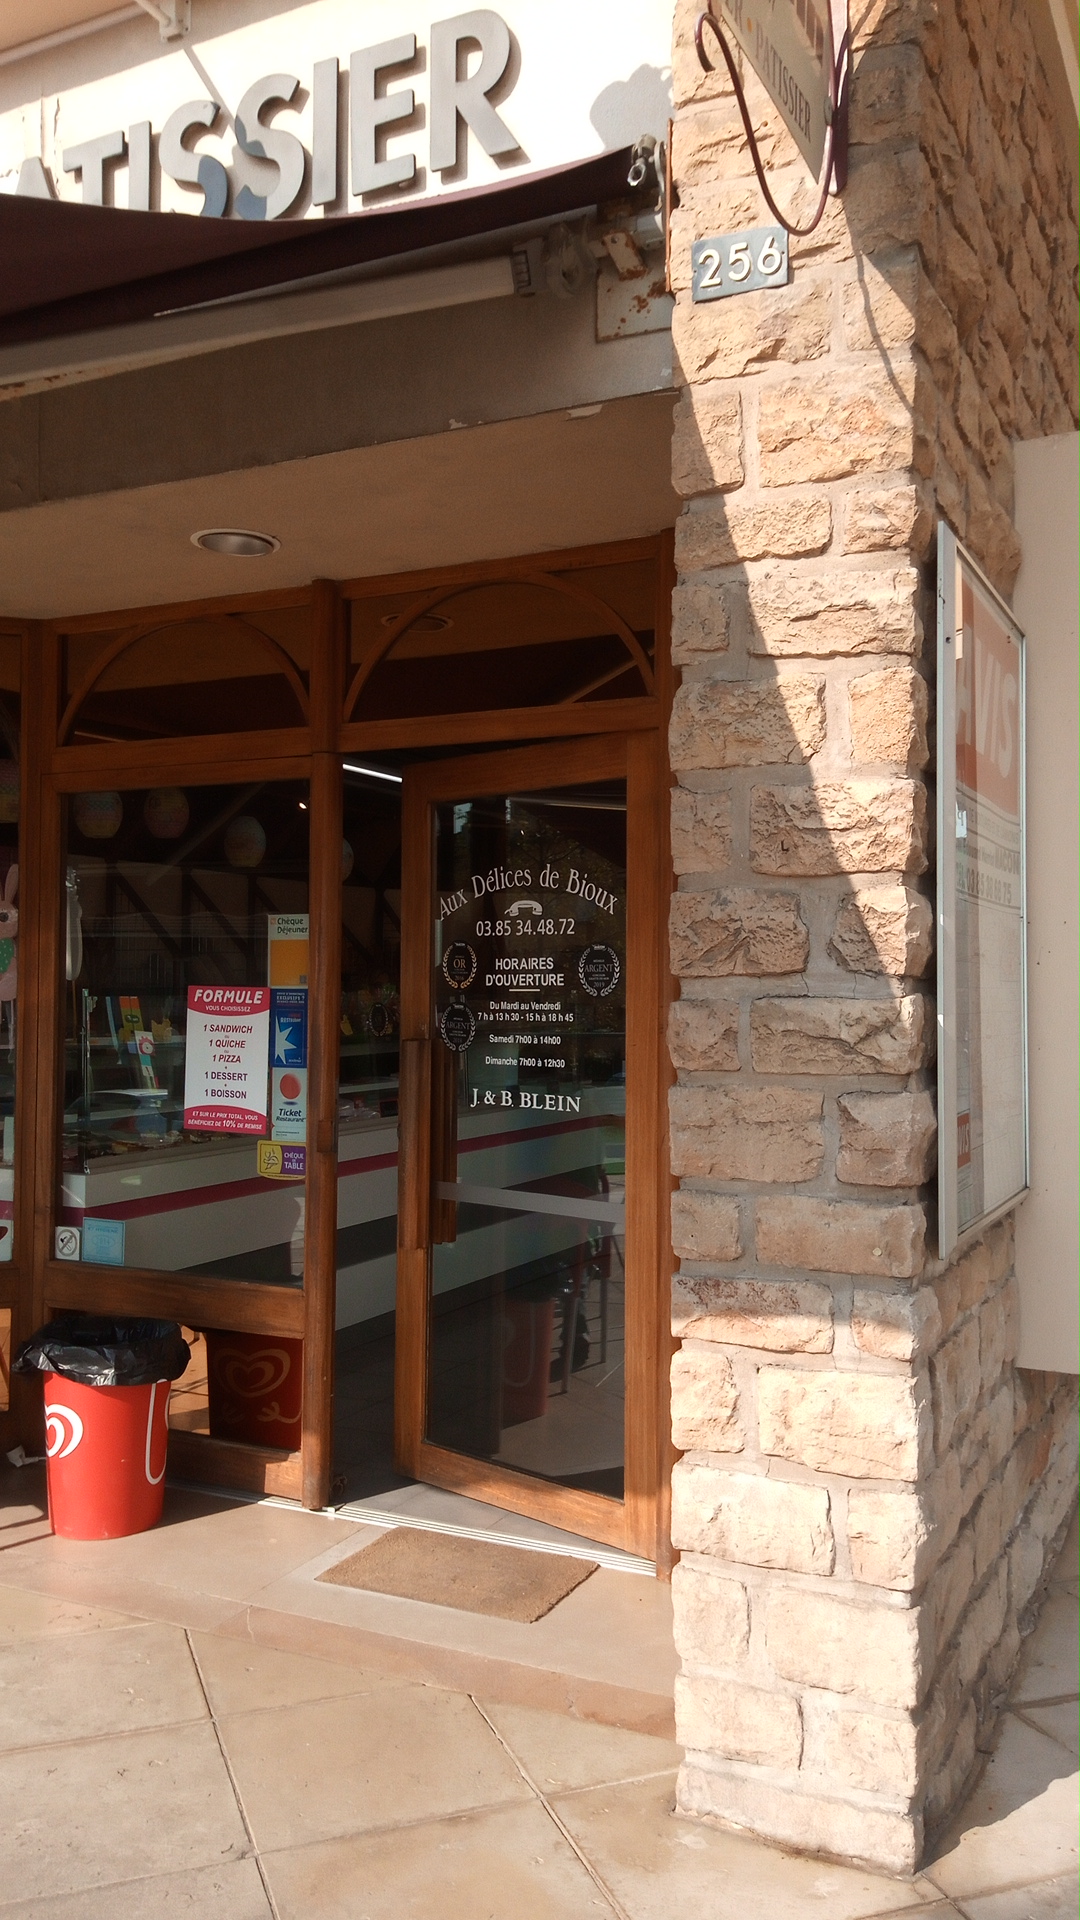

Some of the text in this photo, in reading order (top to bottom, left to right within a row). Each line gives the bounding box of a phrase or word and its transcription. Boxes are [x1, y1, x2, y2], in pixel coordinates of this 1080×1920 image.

[755, 17, 811, 144] PATISSIER
[698, 236, 782, 288] 256
[440, 864, 618, 921] Aux Délices de Bioux
[277, 917, 304, 926] Chèque
[278, 926, 308, 936] Déjeuner
[476, 919, 575, 936] 03.85 34.48.72
[453, 958, 466, 968] OR
[495, 957, 554, 970] HORAIRES
[584, 963, 613, 972] ARGENT
[485, 974, 564, 986] D'OUVERTURE
[194, 989, 263, 1004] FORMULE
[489, 1001, 499, 1010] Du
[500, 1001, 520, 1010] Mardi
[530, 1001, 561, 1010] Vendredi
[477, 1012, 482, 1020] 7
[484, 1012, 488, 1020] h
[489, 1012, 494, 1020] à
[496, 1012, 504, 1020] 13
[504, 1012, 510, 1020] h
[526, 1013, 534, 1021] 15
[535, 1013, 540, 1021] h
[542, 1013, 546, 1022] à
[548, 1014, 557, 1022] 18
[558, 1014, 564, 1022] h
[564, 1014, 574, 1022] 45
[210, 1024, 253, 1034] SANDWICH
[446, 1021, 470, 1030] ARGENT
[216, 1040, 246, 1048] QUICHE
[489, 1034, 561, 1045] Samedi 7h00 à 14h00
[218, 1054, 241, 1063] PIZZA
[485, 1056, 566, 1068] Dimanche 7h00 à 12h30
[204, 1071, 248, 1081] 1 DESSERT
[211, 1089, 247, 1099] BOISSON
[470, 1088, 581, 1112] J. & B. BLEIN
[279, 1108, 302, 1117] Ticket
[284, 1162, 304, 1170] TABLE
